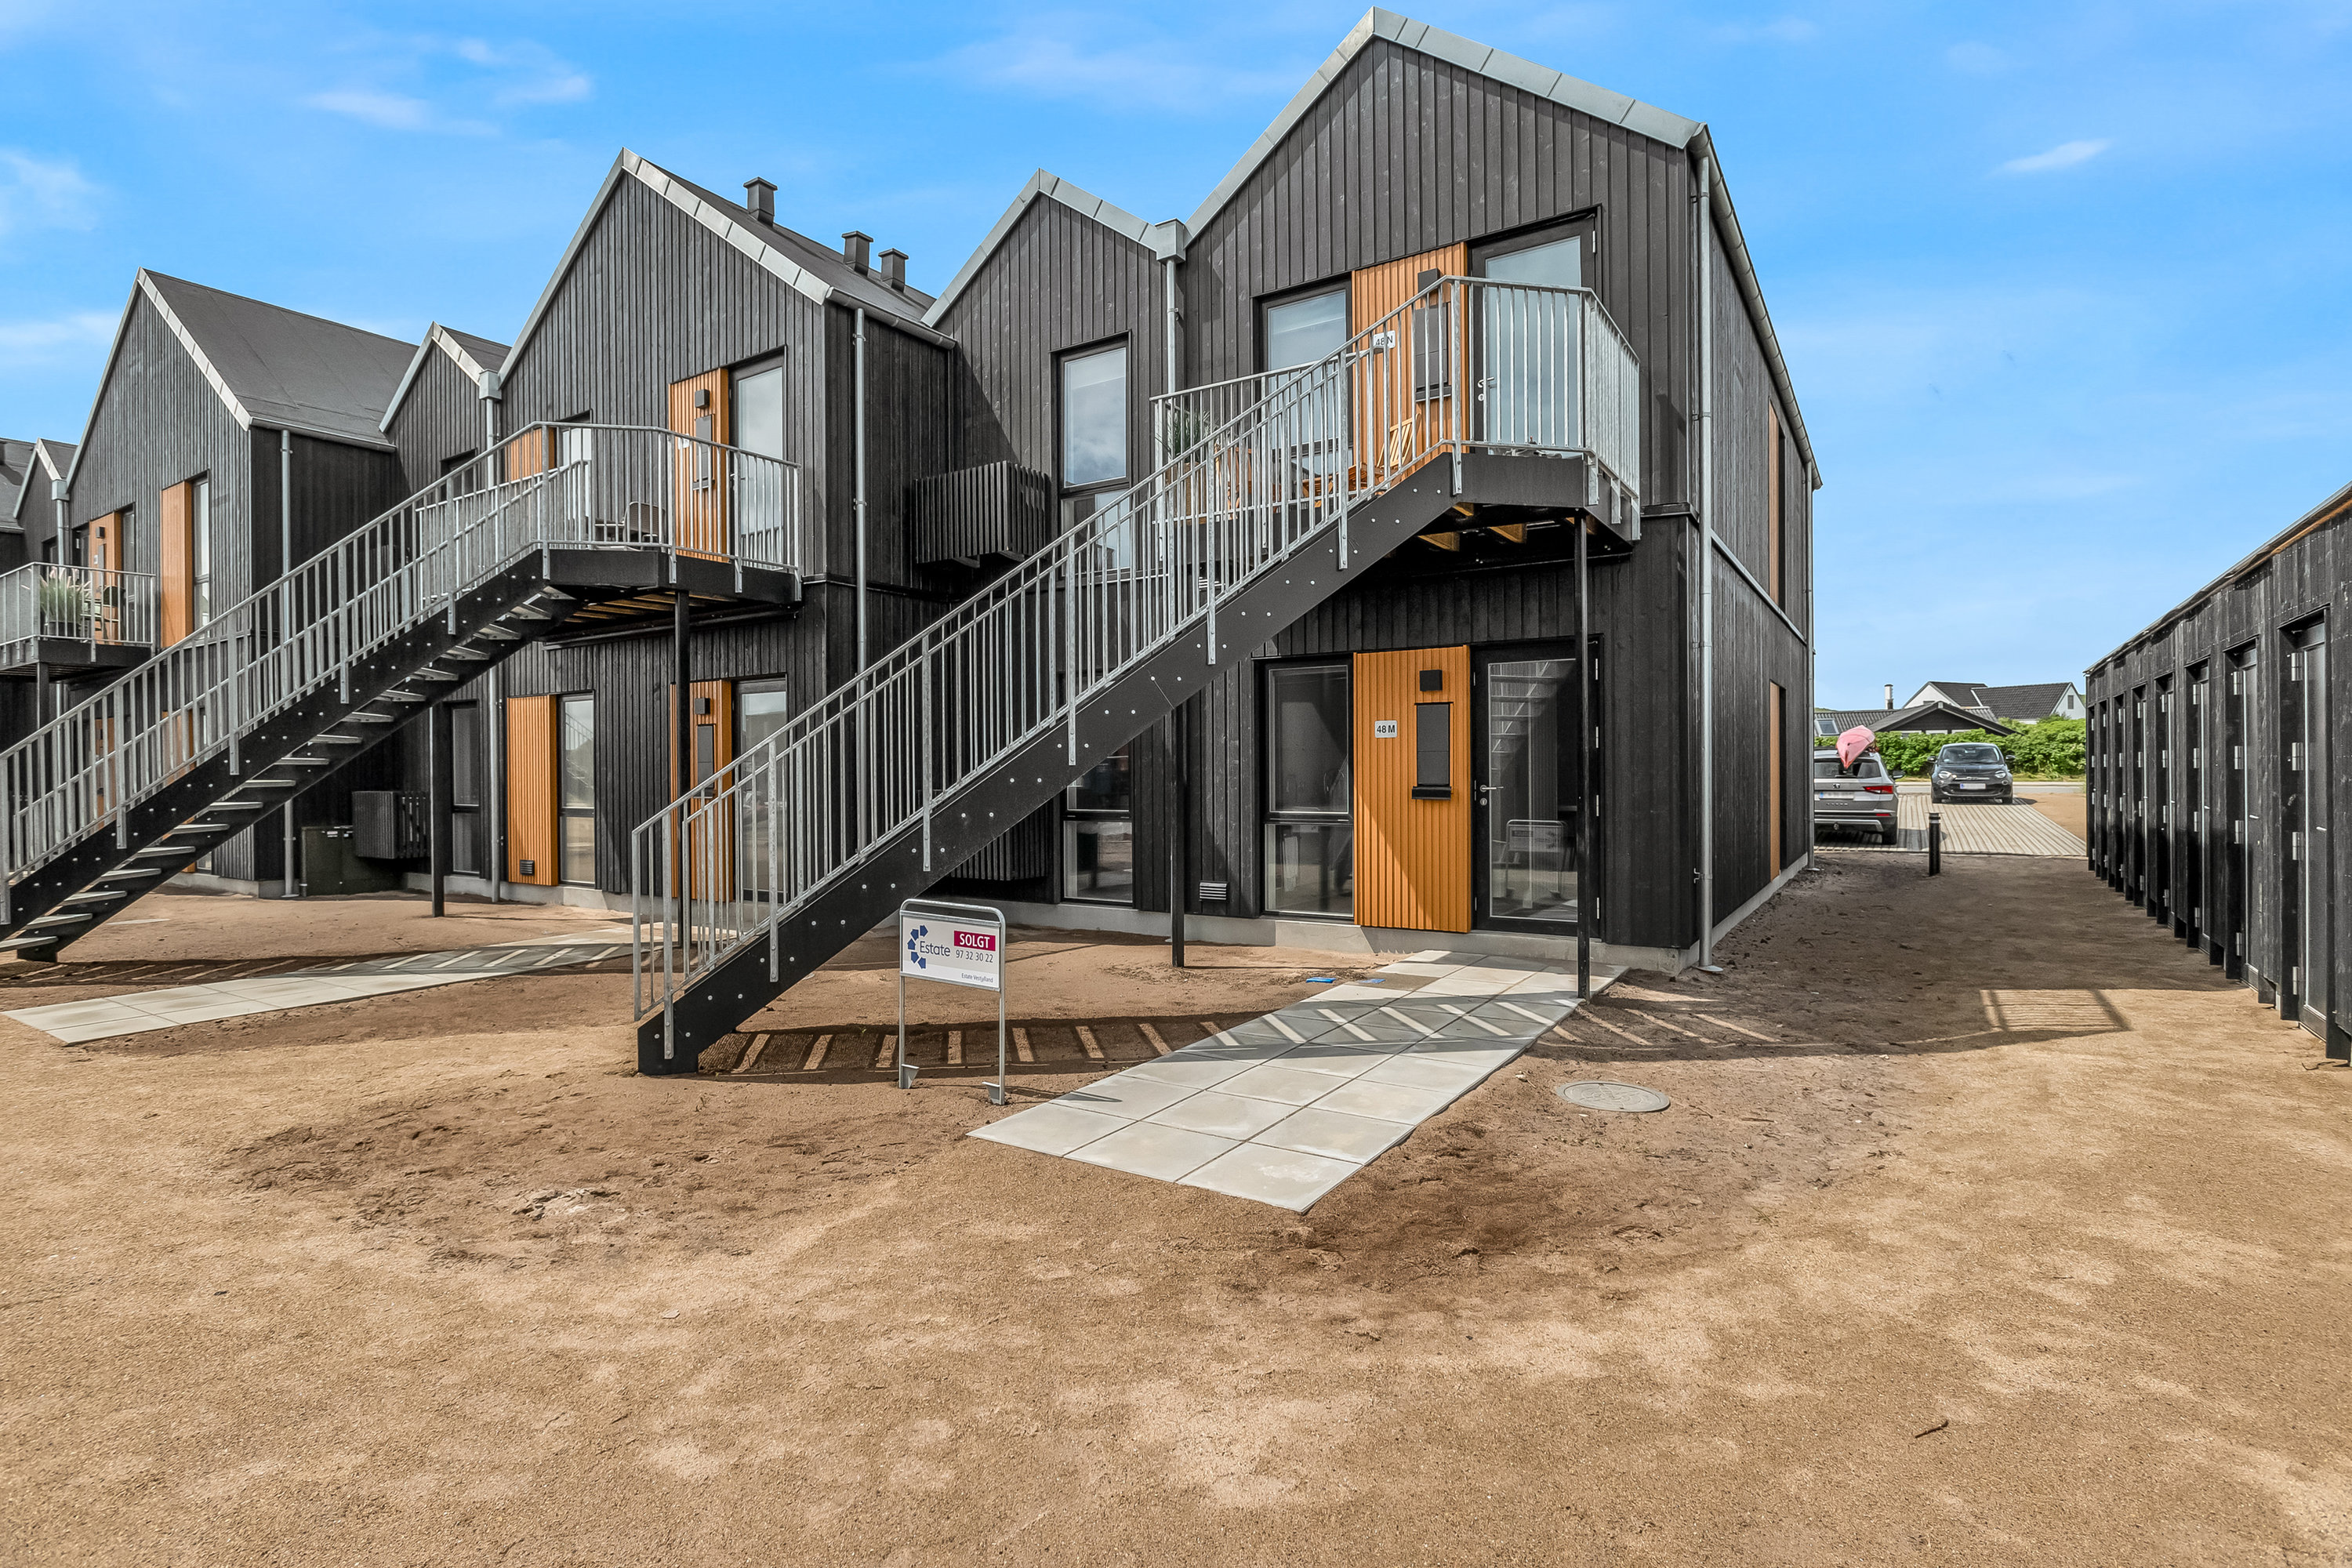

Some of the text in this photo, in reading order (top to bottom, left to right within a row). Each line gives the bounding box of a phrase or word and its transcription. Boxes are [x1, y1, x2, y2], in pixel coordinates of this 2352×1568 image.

[1387, 336, 1392, 344] N
[1377, 724, 1395, 733] 48 M
[960, 933, 990, 948] SOLGT
[920, 941, 950, 956] Estate
[956, 949, 993, 963] 97 32 30 22
